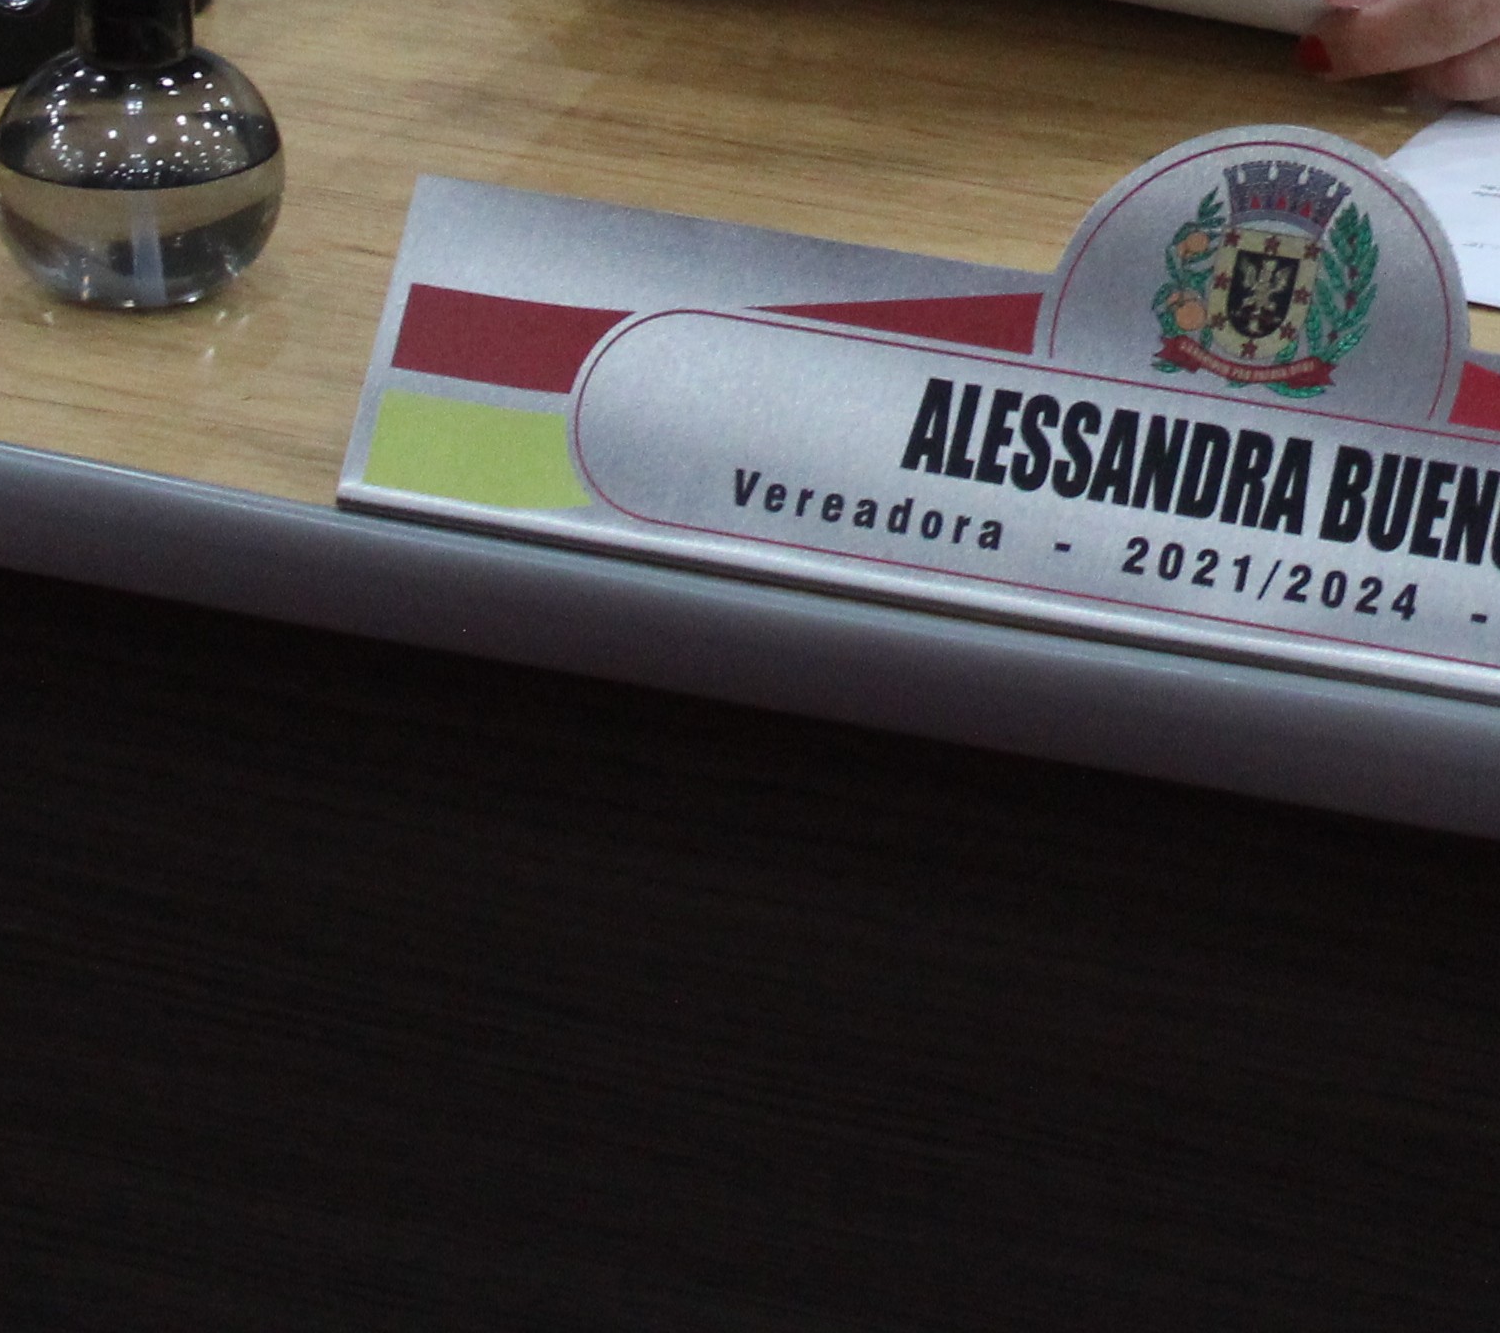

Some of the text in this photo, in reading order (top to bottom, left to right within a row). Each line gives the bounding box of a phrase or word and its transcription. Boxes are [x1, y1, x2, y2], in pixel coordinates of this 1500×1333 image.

[900, 377, 1313, 536] ALESSANDRA
[733, 468, 1003, 551] Vereadora
[1121, 536, 1419, 621] 2021/2024
